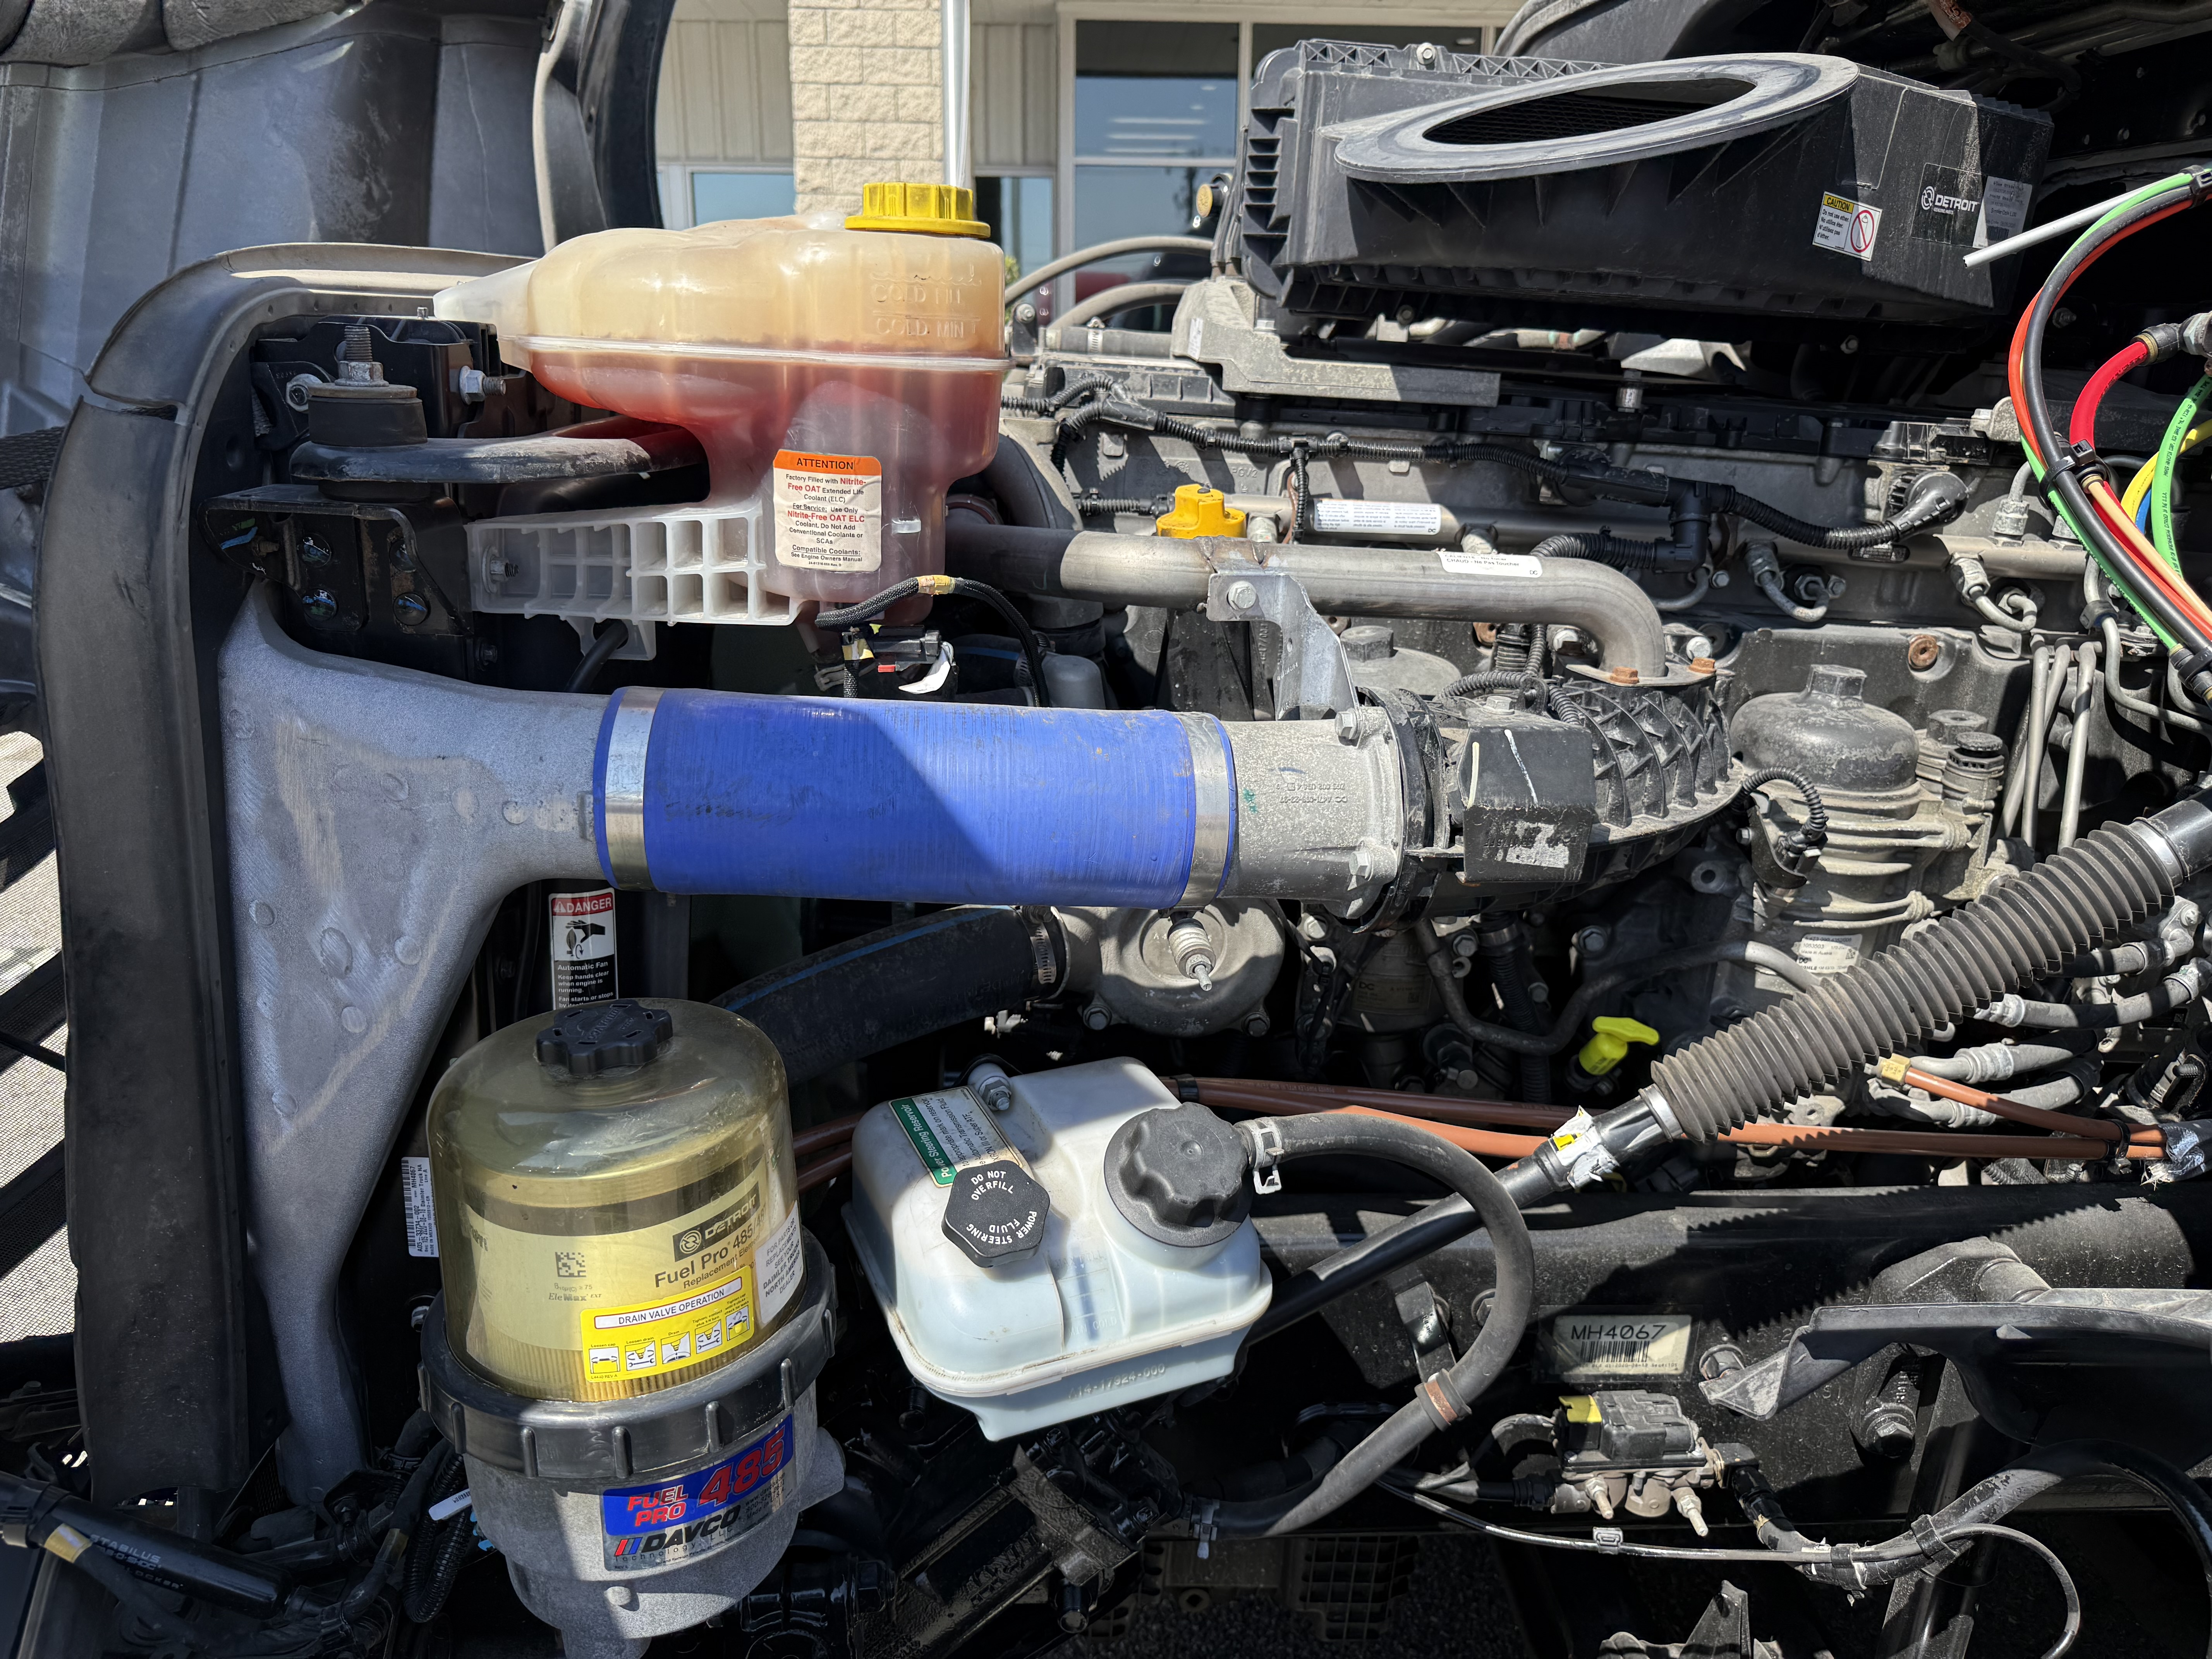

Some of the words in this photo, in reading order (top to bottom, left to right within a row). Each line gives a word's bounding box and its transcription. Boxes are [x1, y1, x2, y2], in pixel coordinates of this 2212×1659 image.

[1827, 197, 1850, 211] CAUTION
[1935, 194, 1978, 212] DETROIT
[877, 318, 928, 336] COLD
[937, 321, 963, 338] MIN
[797, 458, 853, 470] ATTENTION
[786, 474, 806, 483] Factory
[787, 510, 827, 521] Nitrite-Free
[789, 527, 826, 536] Conventional
[792, 544, 827, 554] Compatible
[567, 897, 612, 913] DANGER
[1359, 981, 1374, 990] DC
[936, 1098, 949, 1109] Fluid
[901, 1104, 924, 1132] Reservoir
[946, 1109, 967, 1137] Transmission
[971, 1122, 983, 1135] Super
[939, 1123, 950, 1135] mark
[919, 1131, 939, 1157] Steering
[945, 1135, 966, 1161] appropriate
[964, 1137, 982, 1160] Automatic
[933, 1158, 952, 1178] Power
[971, 1174, 984, 1185] DO
[987, 1170, 1006, 1179] NOT
[971, 1181, 1014, 1200] OVERFILL
[705, 1194, 756, 1240] DETROIT
[989, 1219, 1020, 1233] FLUID
[1016, 1211, 1037, 1238] POWER
[767, 1243, 778, 1256] FOR
[778, 1225, 790, 1245] PARTS
[966, 1224, 1013, 1245] STEERING
[766, 1225, 797, 1267] REPLACEMENTS
[775, 1256, 783, 1269] SEE
[783, 1240, 794, 1258] YOUR
[655, 1260, 694, 1288] Fuel
[701, 1247, 728, 1269] Pro
[684, 1254, 737, 1288] Replacement
[739, 1233, 760, 1257] Element
[763, 1261, 787, 1289] DAIMLER
[787, 1238, 800, 1264] TRUCKS
[766, 1276, 785, 1297] NORTH
[786, 1250, 800, 1276] AMERICA
[780, 1270, 795, 1294] DEALER
[619, 1312, 647, 1324] DRAIN
[649, 1306, 676, 1319] VALVE
[679, 1289, 724, 1312] OPERATION
[709, 1309, 722, 1317] contact
[1093, 1317, 1117, 1330] COLD
[1571, 1324, 1666, 1340] MH4067
[635, 1501, 687, 1527] PRO
[697, 1425, 785, 1507] 485
[627, 1484, 689, 1511] FUEL
[745, 1472, 785, 1506] www.davco.com
[747, 1506, 762, 1519] Made
[641, 1504, 741, 1554] DAVCO
[90, 1534, 161, 1563] STABILUS
